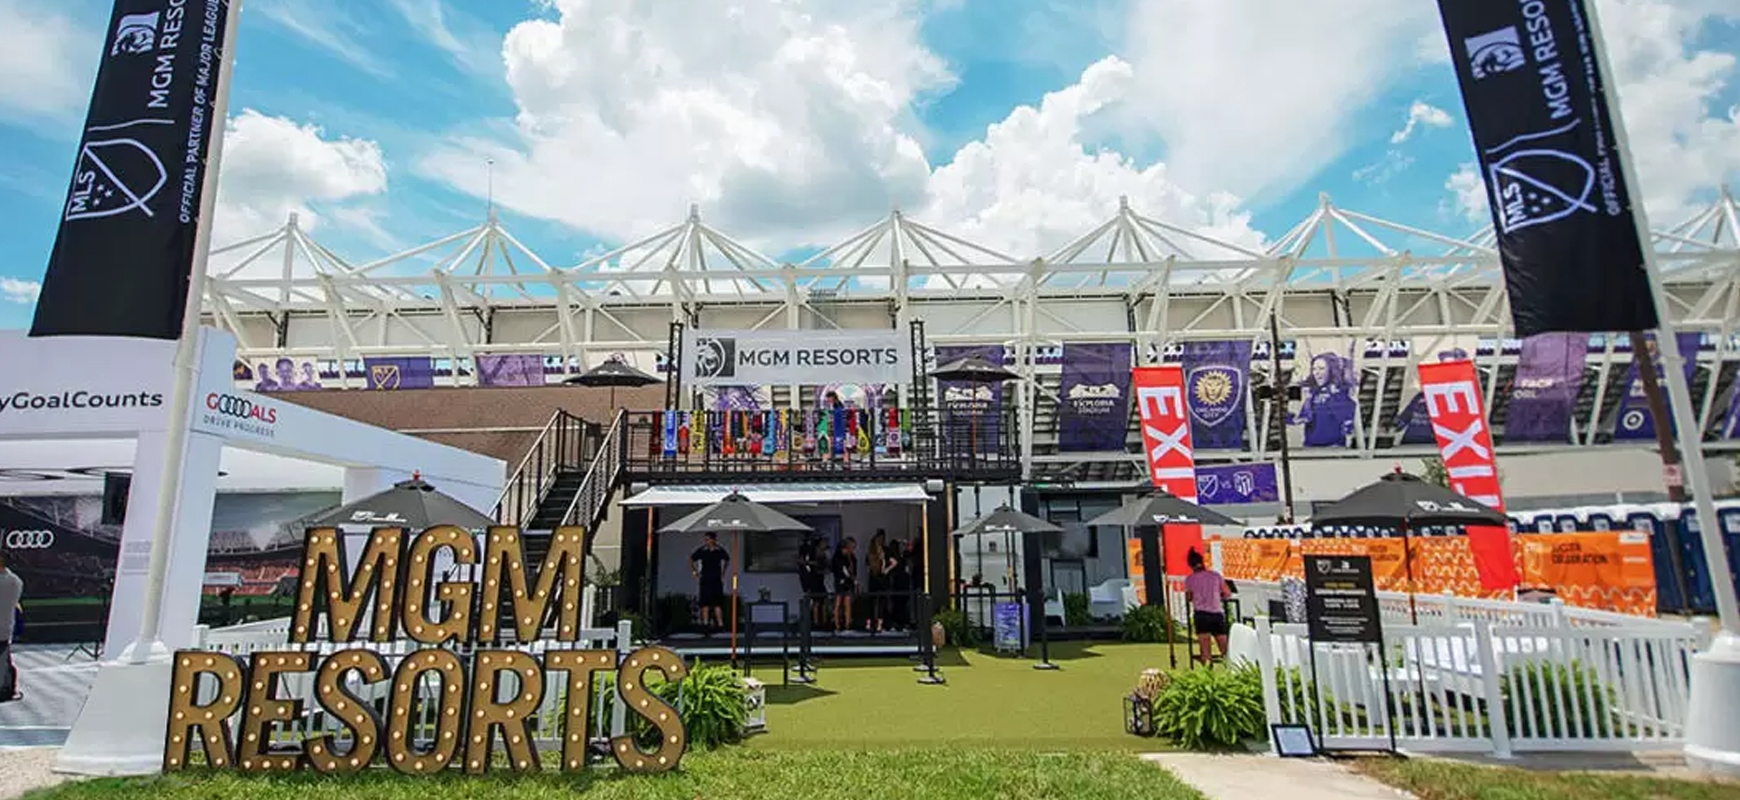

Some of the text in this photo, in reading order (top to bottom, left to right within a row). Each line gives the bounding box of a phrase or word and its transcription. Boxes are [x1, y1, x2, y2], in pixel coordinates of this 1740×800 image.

[148, 55, 176, 107] MGM
[196, 43, 213, 86] MAJOR
[1518, 0, 1572, 119] MGM RESO
[194, 87, 207, 105] OF
[186, 107, 204, 163] PARTNER
[70, 170, 96, 213] MLS
[179, 167, 197, 223] OFFICIAL
[1503, 183, 1527, 225] MLS
[738, 348, 899, 366] MGM RESORTS
[290, 525, 588, 643] MGM
[163, 647, 690, 774] RESORTS
